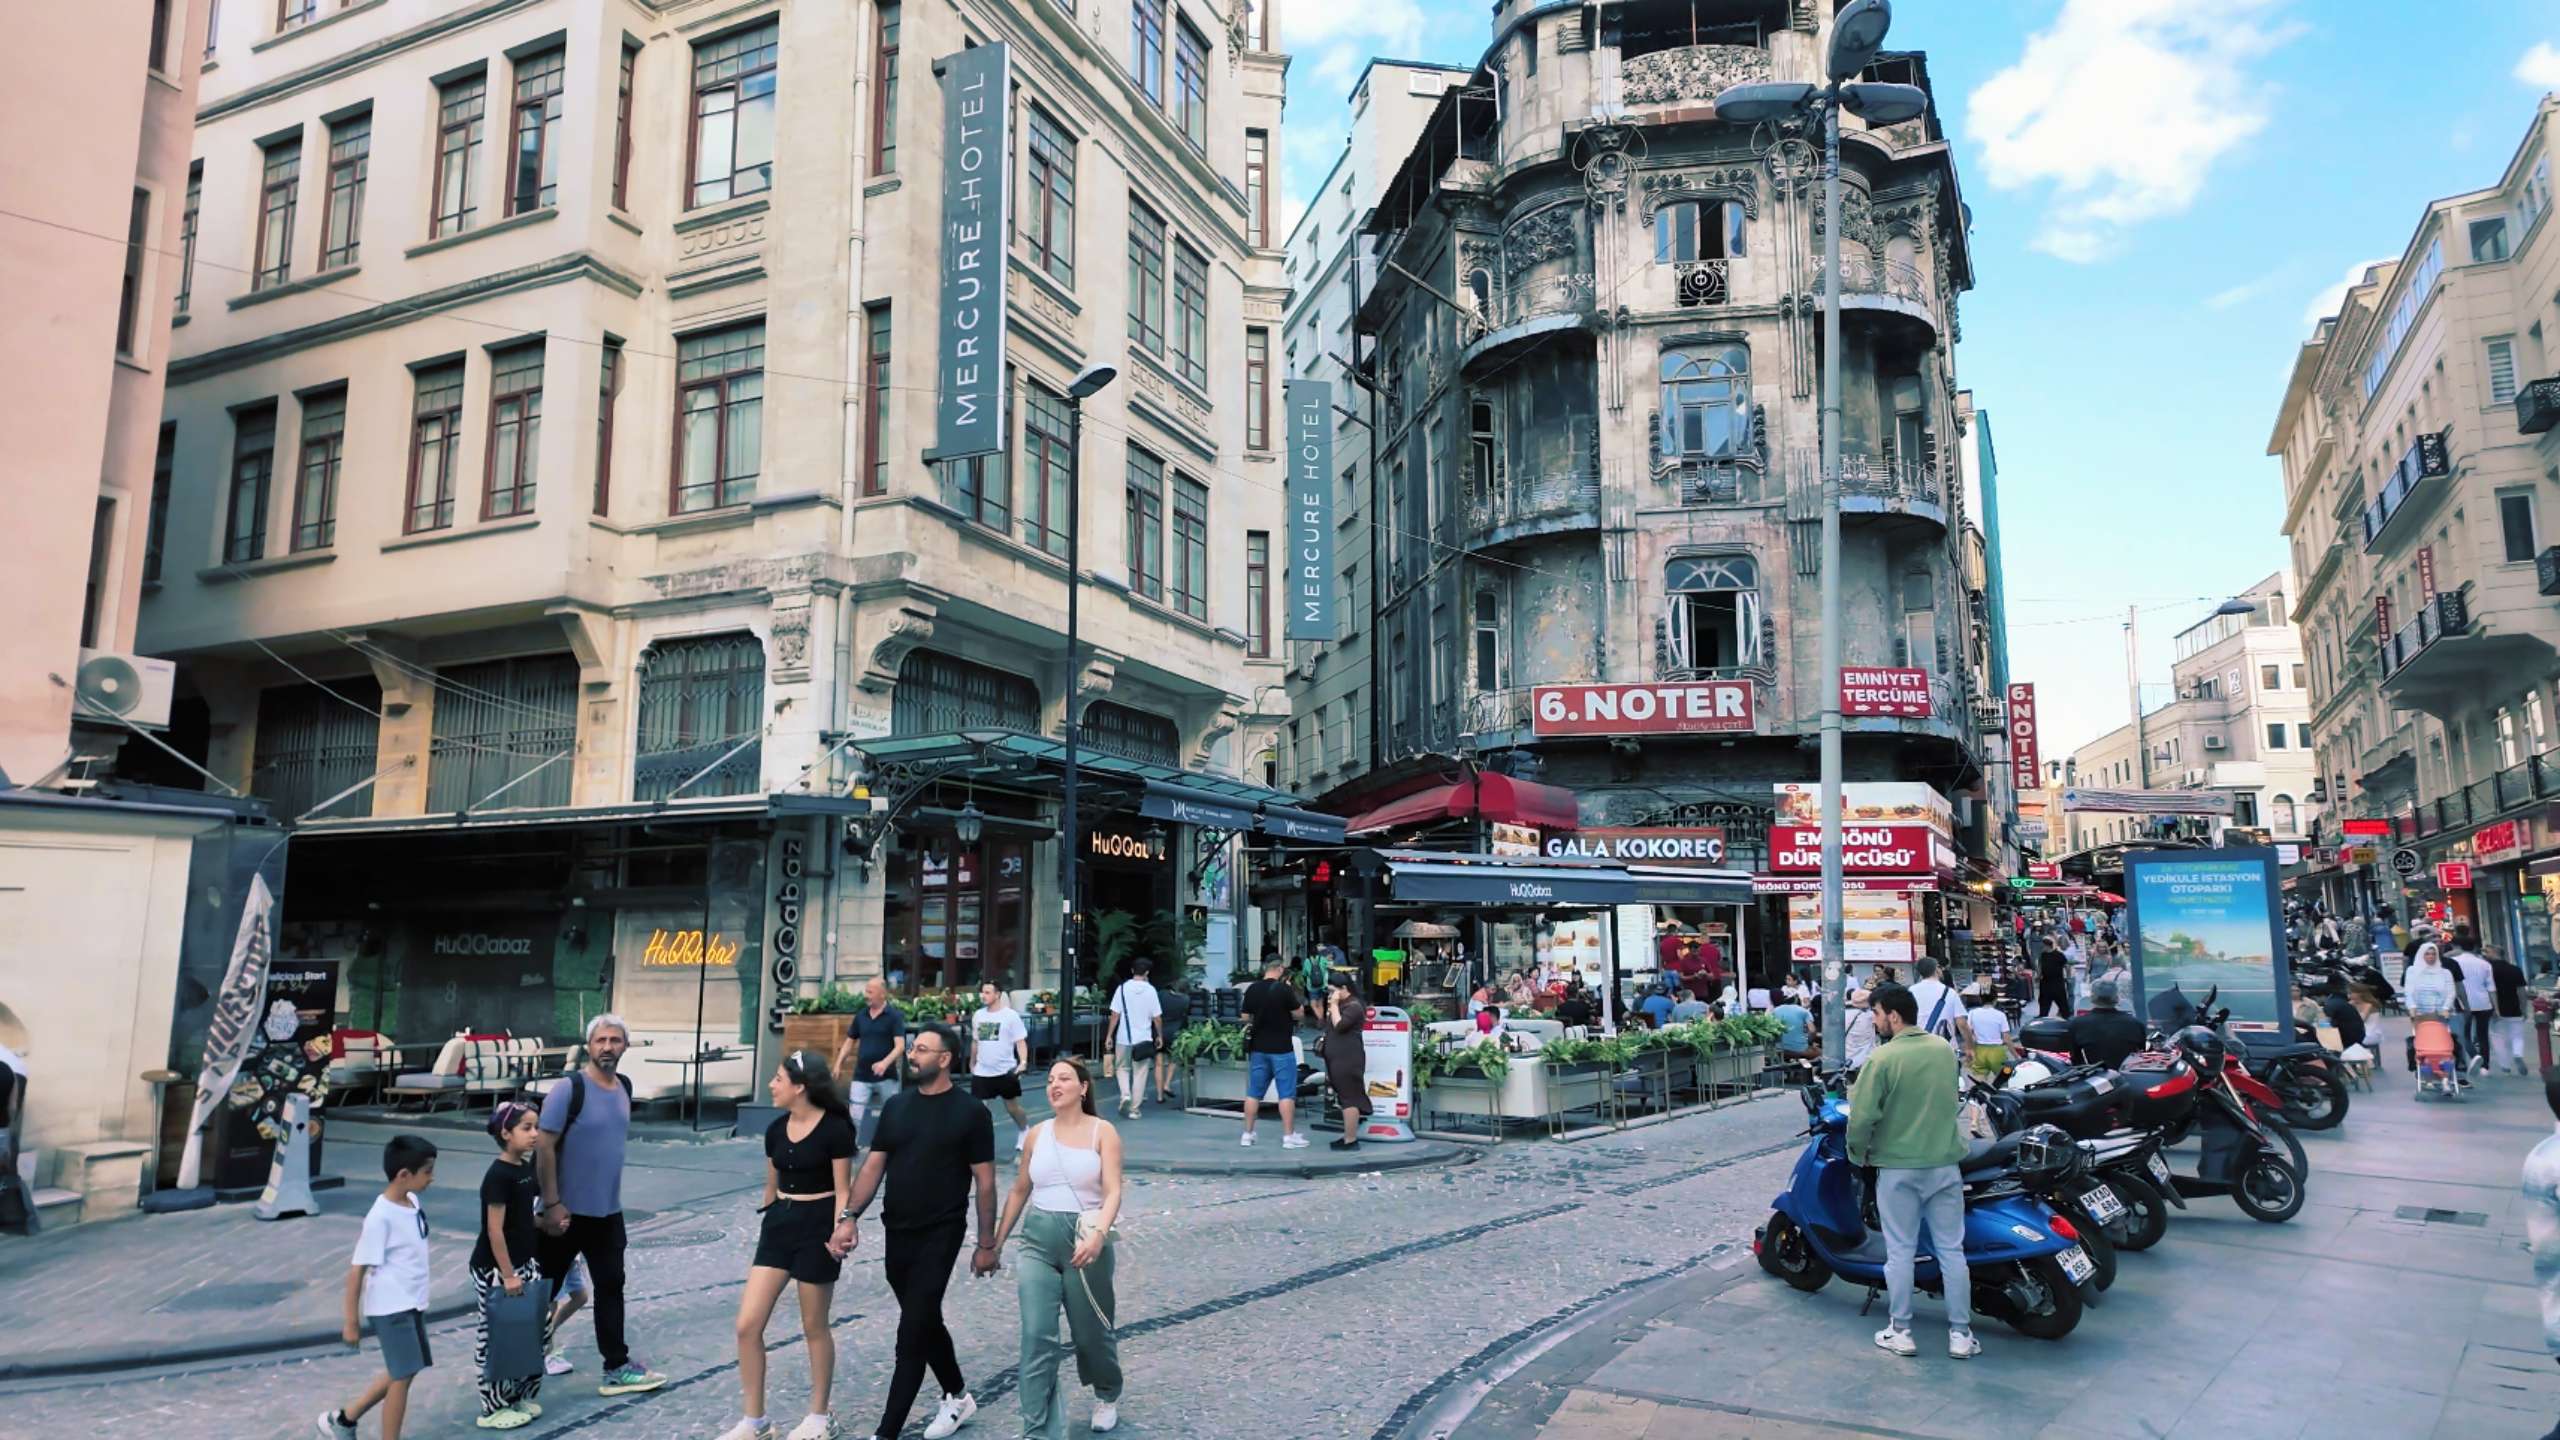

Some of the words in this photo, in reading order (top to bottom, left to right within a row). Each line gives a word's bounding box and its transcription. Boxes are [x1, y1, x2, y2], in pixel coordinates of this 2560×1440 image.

[960, 71, 985, 202] HOTEL
[955, 221, 982, 426] MERCURE
[1303, 398, 1320, 480] HOTEL
[1303, 493, 1321, 622] MERCURE
[1844, 671, 1921, 686] EMNİYET
[1843, 688, 1928, 703] TERCÜME
[1795, 828, 1892, 846] EMÖNÜ
[1547, 838, 1610, 858] GALA
[1615, 838, 1723, 863] KOKOREÇ
[1779, 848, 1910, 866] DÜRMCÜSÜ
[2142, 873, 2199, 884] YEDİKULE
[2170, 884, 2233, 894] OTOPARKI
[434, 933, 531, 955] HuQQabaz
[642, 928, 737, 967] HuQQabaz
[304, 970, 326, 980] Start
